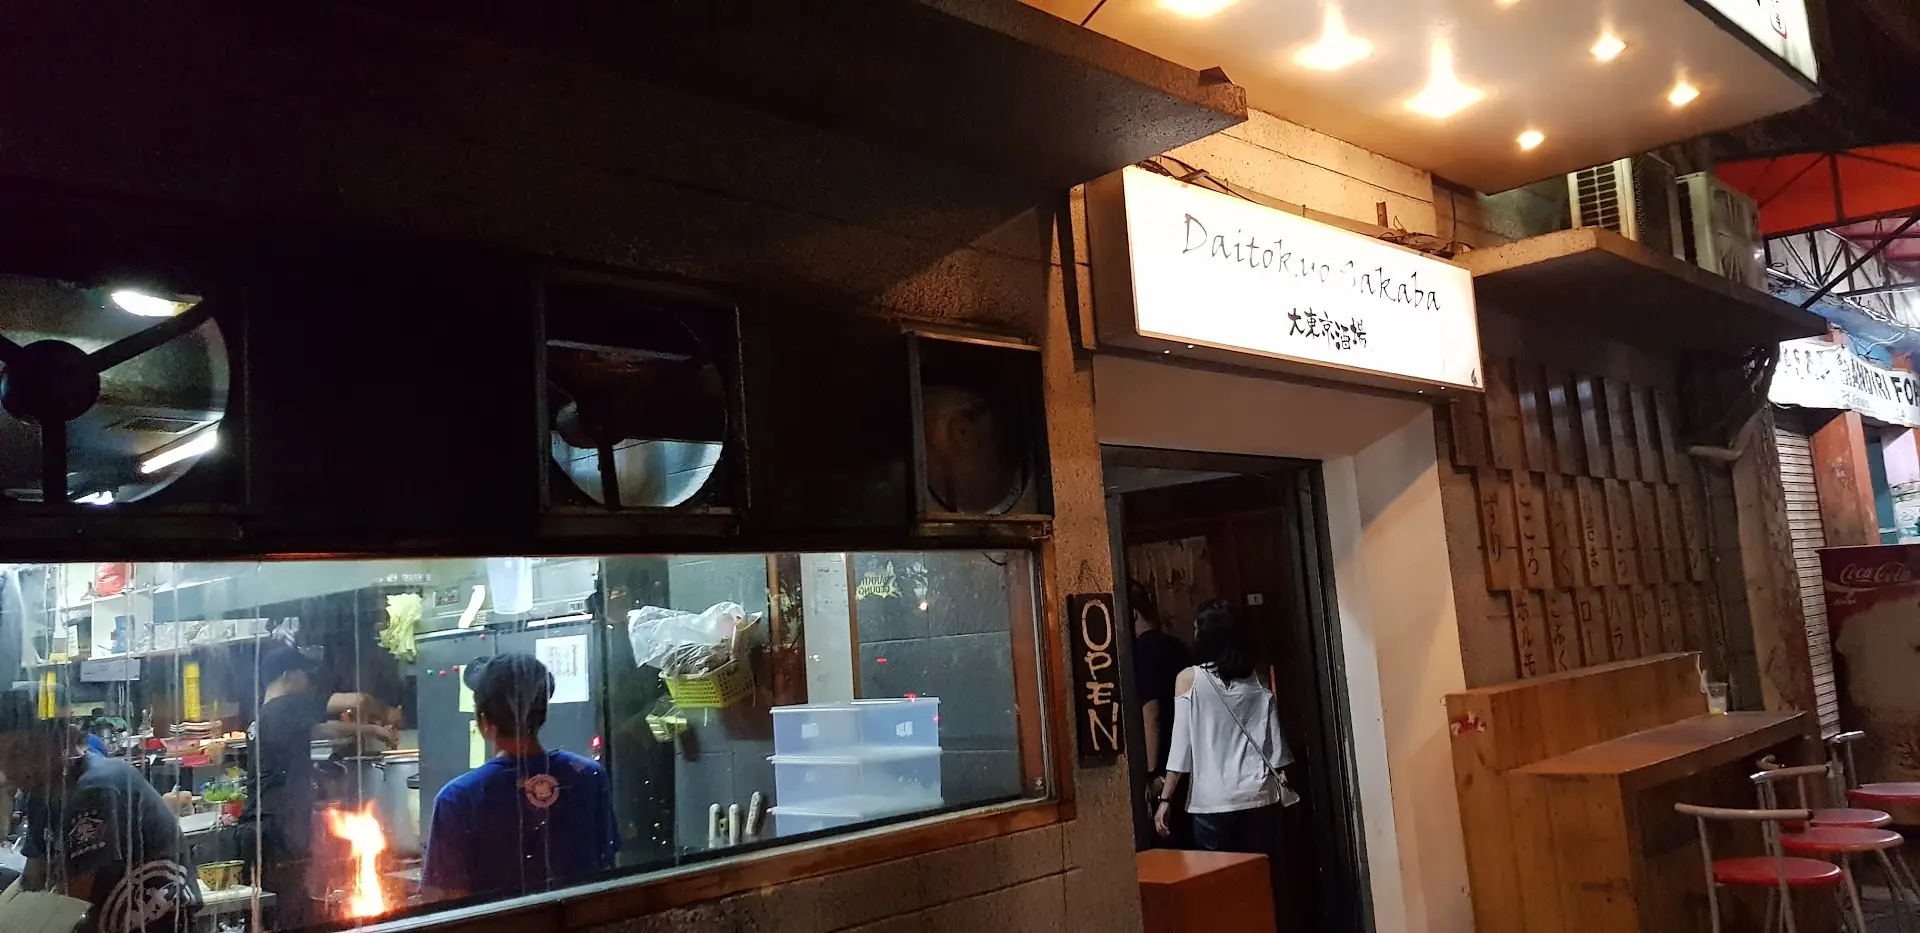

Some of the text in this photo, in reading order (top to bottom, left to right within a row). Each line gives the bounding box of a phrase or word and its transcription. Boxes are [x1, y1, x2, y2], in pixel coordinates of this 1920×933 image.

[1287, 306, 1368, 351] 大東京酒場
[1081, 598, 1119, 752] OPEN
